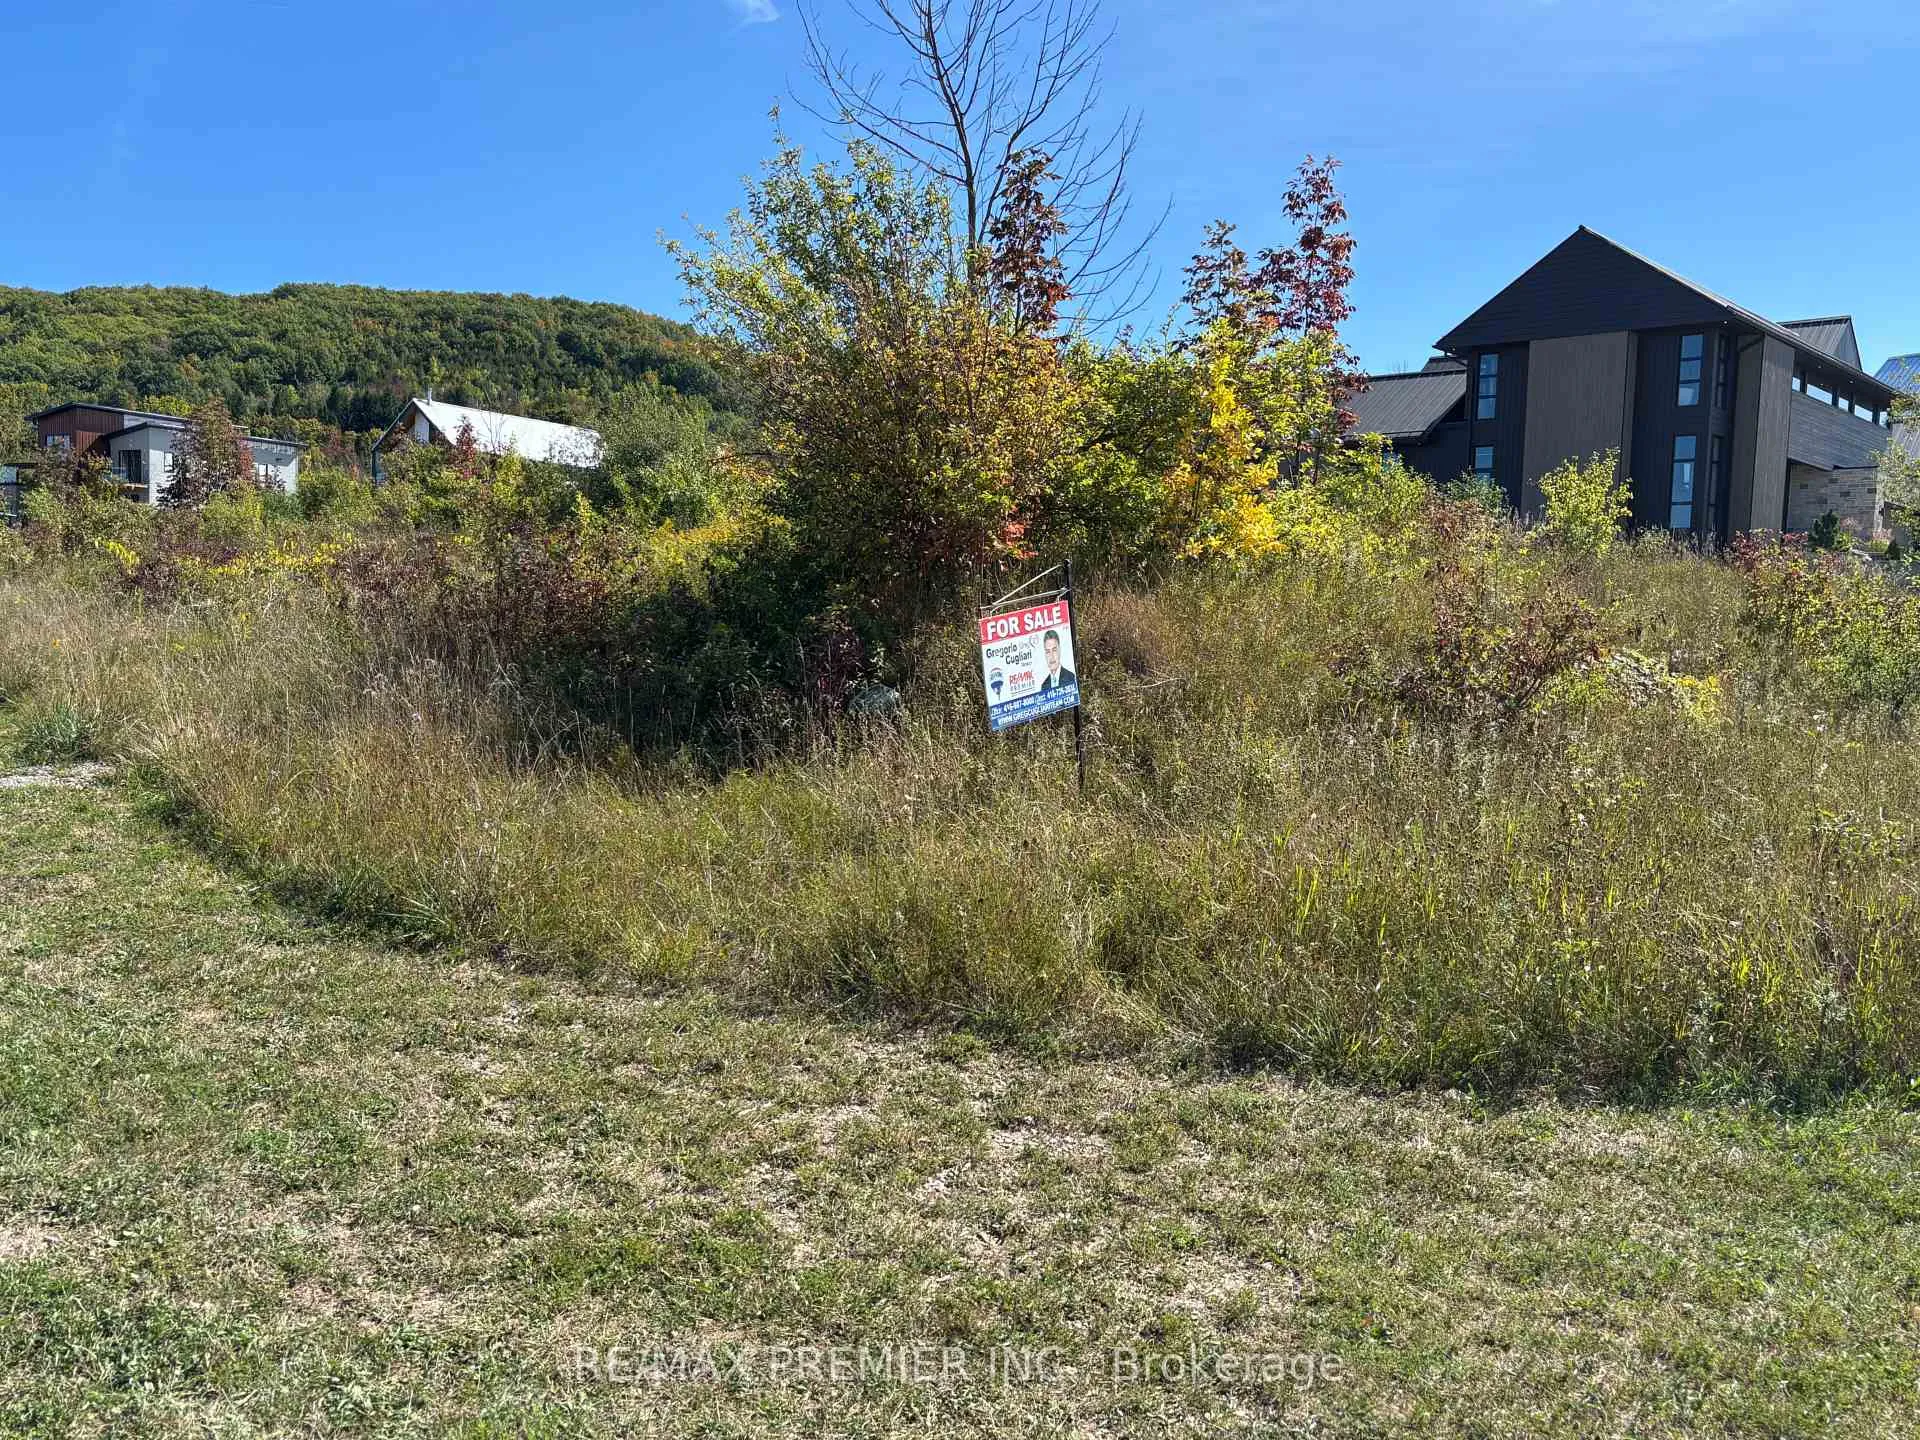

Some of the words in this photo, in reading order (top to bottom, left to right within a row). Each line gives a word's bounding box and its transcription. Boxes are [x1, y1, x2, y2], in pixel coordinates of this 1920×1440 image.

[987, 616, 1020, 640] FOR
[1024, 606, 1062, 632] SALE
[986, 642, 1018, 659] Gregorio
